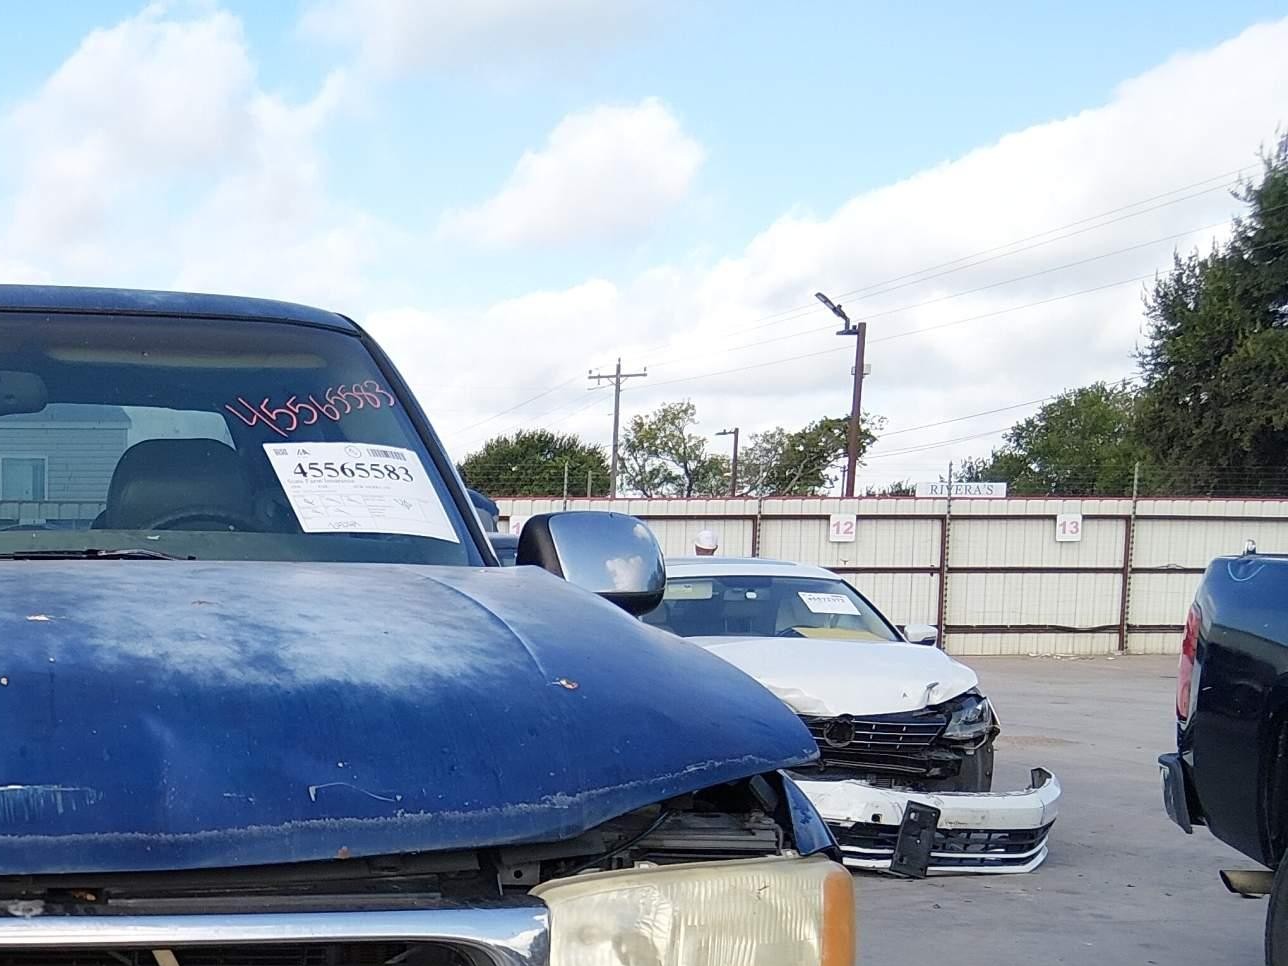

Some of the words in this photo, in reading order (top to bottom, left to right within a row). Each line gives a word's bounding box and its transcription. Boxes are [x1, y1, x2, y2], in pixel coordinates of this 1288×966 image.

[224, 379, 395, 438] 45565583
[293, 462, 414, 482] 45565583
[832, 520, 854, 535] 12
[1058, 520, 1080, 535] 13
